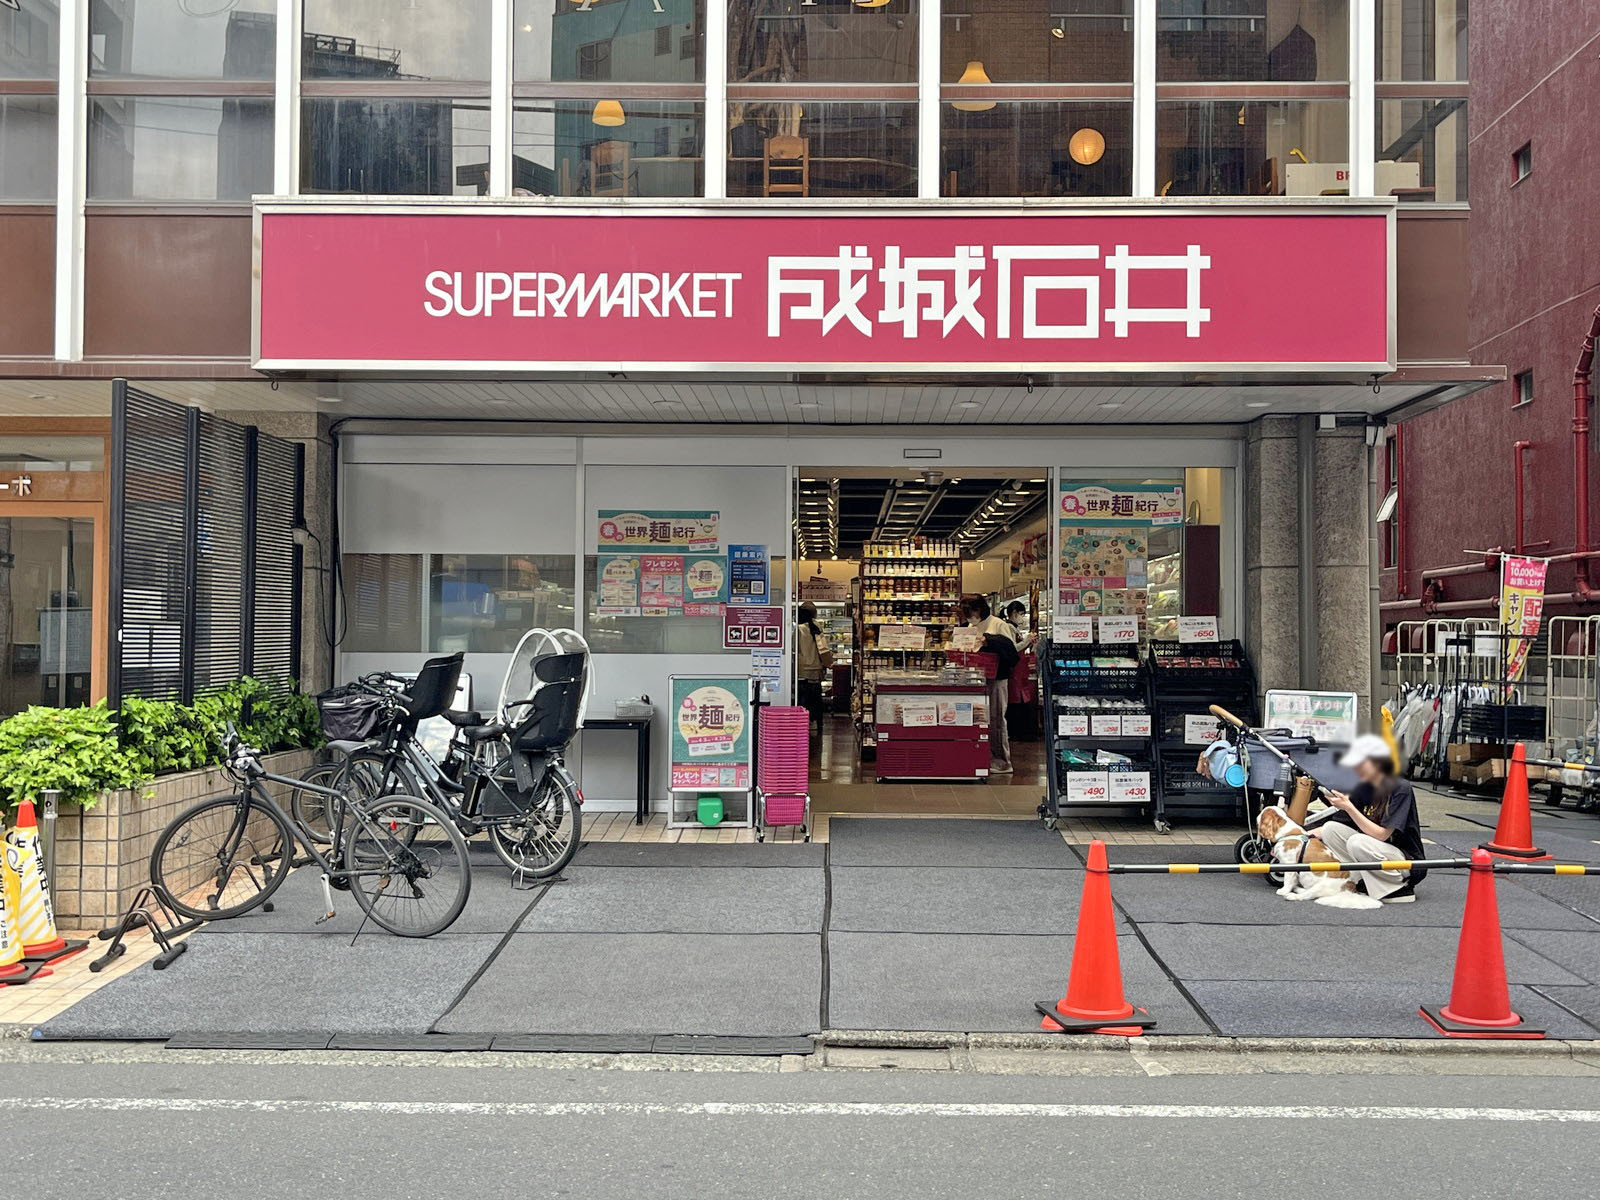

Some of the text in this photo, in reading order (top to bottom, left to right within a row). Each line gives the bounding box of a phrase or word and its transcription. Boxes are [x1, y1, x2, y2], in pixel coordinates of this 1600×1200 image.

[424, 271, 742, 318] SUPERMARKET
[768, 245, 1211, 338] 成城石井
[1087, 787, 1105, 795] 490
[1128, 787, 1147, 795] 430
